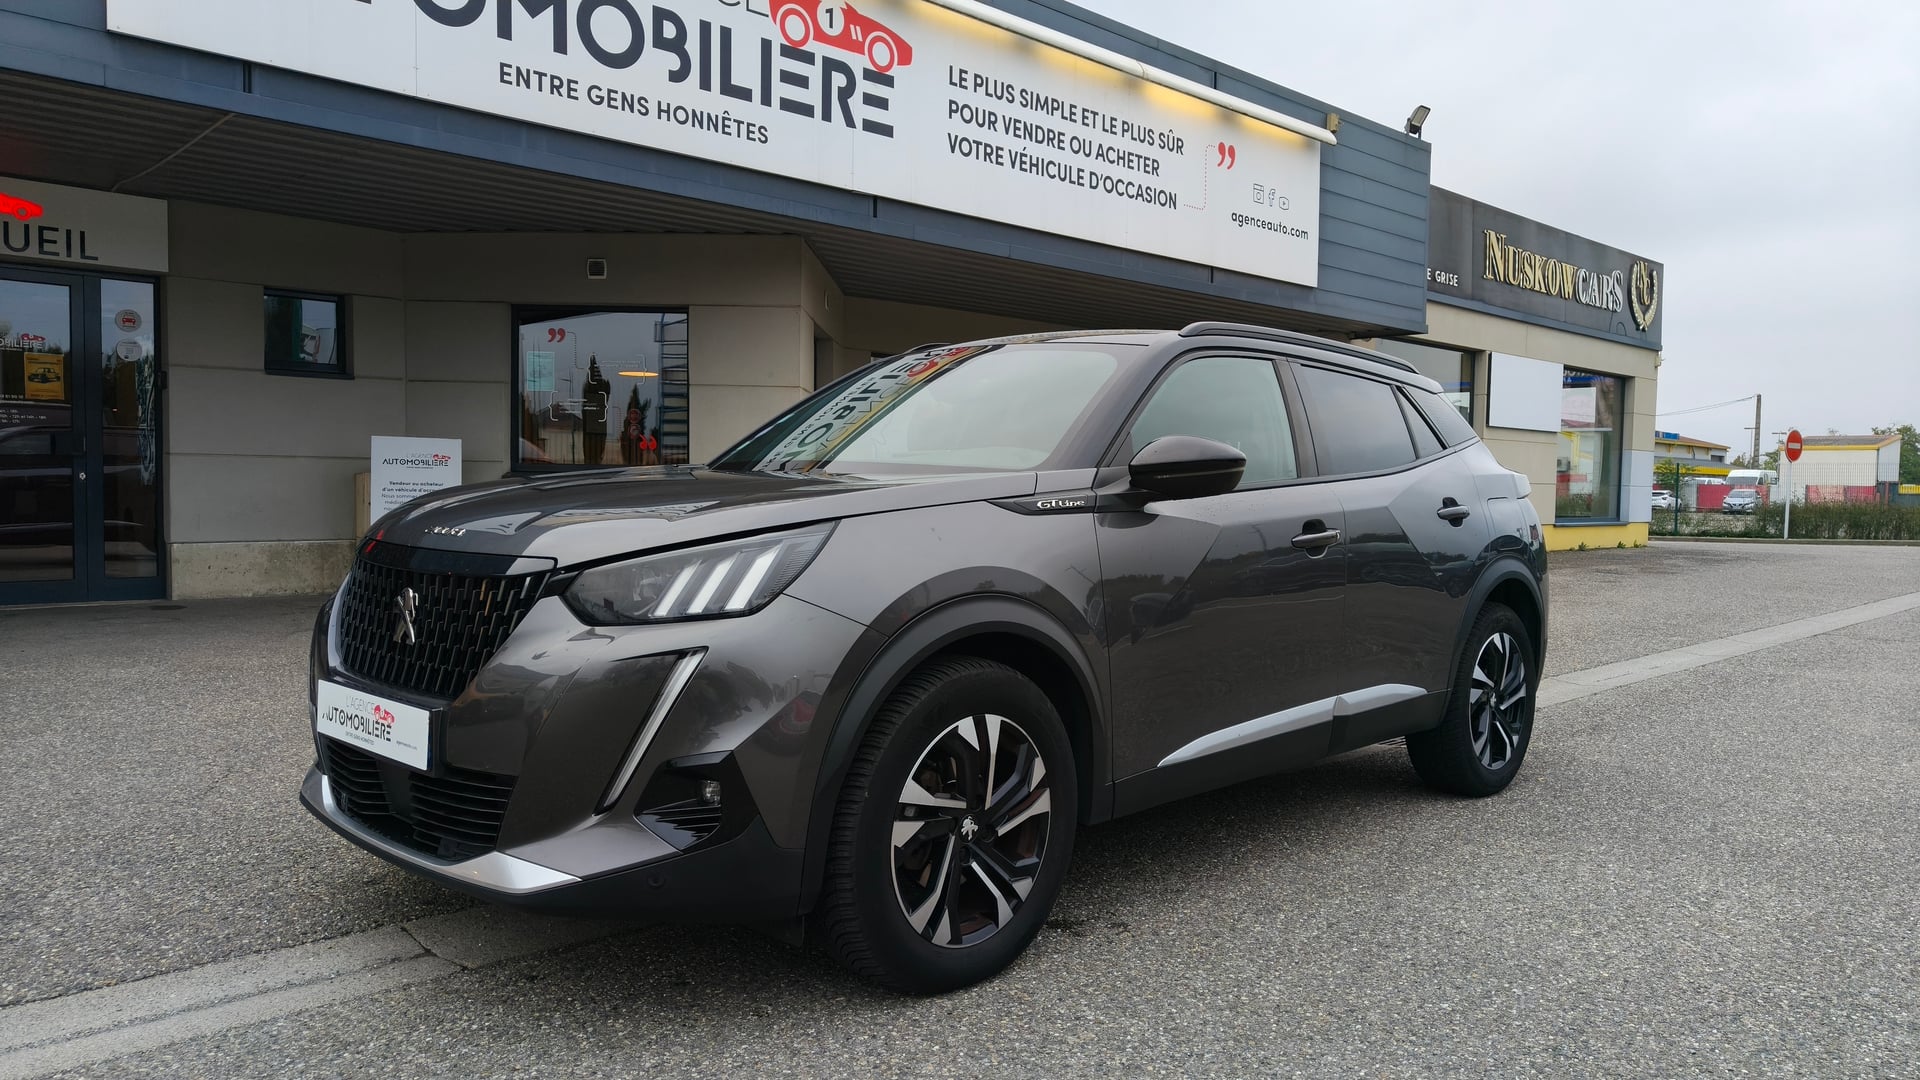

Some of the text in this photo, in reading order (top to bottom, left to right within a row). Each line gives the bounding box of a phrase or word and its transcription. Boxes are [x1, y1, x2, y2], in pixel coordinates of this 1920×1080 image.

[499, 62, 769, 145] ENTRE GENS HONNÊTES
[948, 99, 1160, 177] POUR VENDRE OU ACHETER
[949, 65, 1185, 156] LE PLUS SIMPLE ET LE PLUS SÛR
[946, 132, 1178, 211] VOTRE VÉHICULE D'OCCASION
[1231, 212, 1309, 240] agenceauto.com
[1435, 270, 1459, 287] GRISE
